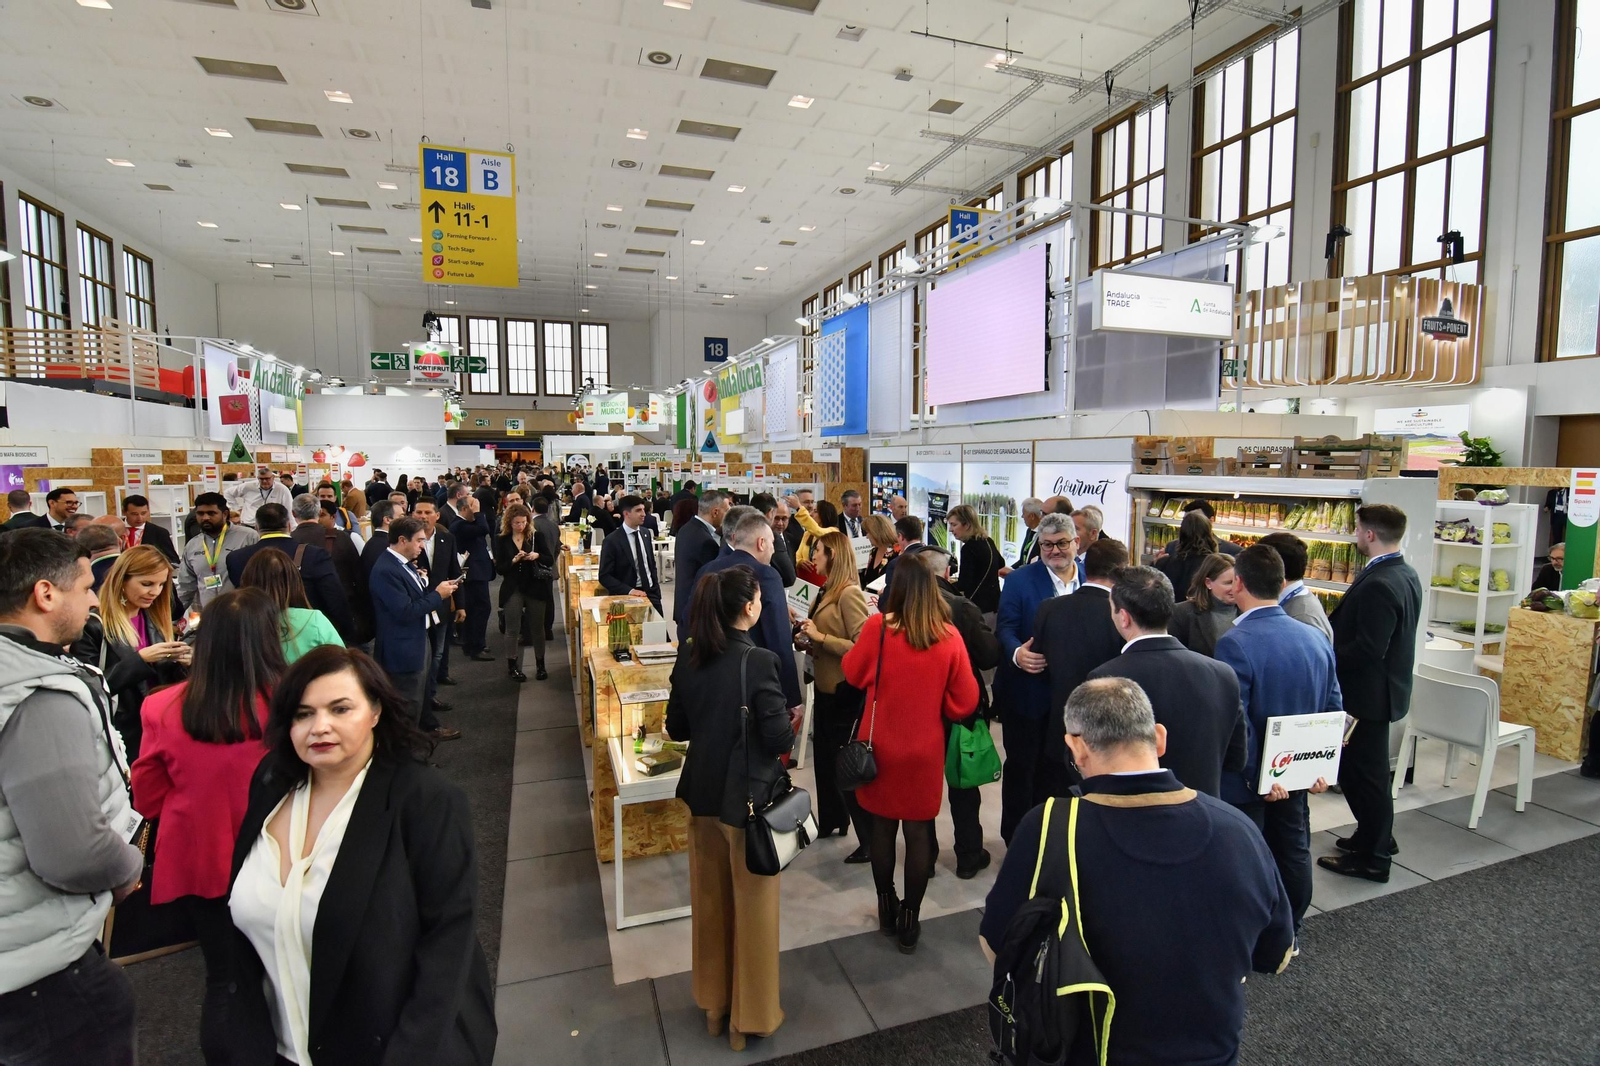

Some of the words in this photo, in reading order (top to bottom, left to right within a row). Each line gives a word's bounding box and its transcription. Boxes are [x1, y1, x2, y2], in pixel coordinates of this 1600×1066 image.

[436, 152, 454, 162] Hall
[481, 158, 501, 167] Aisle
[431, 166, 459, 187] 18
[483, 169, 499, 190] B
[453, 202, 475, 211] Halls
[454, 212, 489, 229] 11-1
[955, 223, 974, 240] 18
[1107, 299, 1130, 308] TRADE
[1423, 319, 1443, 331] FRUITS
[1446, 322, 1467, 334] PONENT
[708, 343, 724, 357] 18
[600, 400, 617, 408] REGION
[972, 448, 993, 456] ESPÁRRAGO
[1053, 475, 1117, 506] Gourmet
